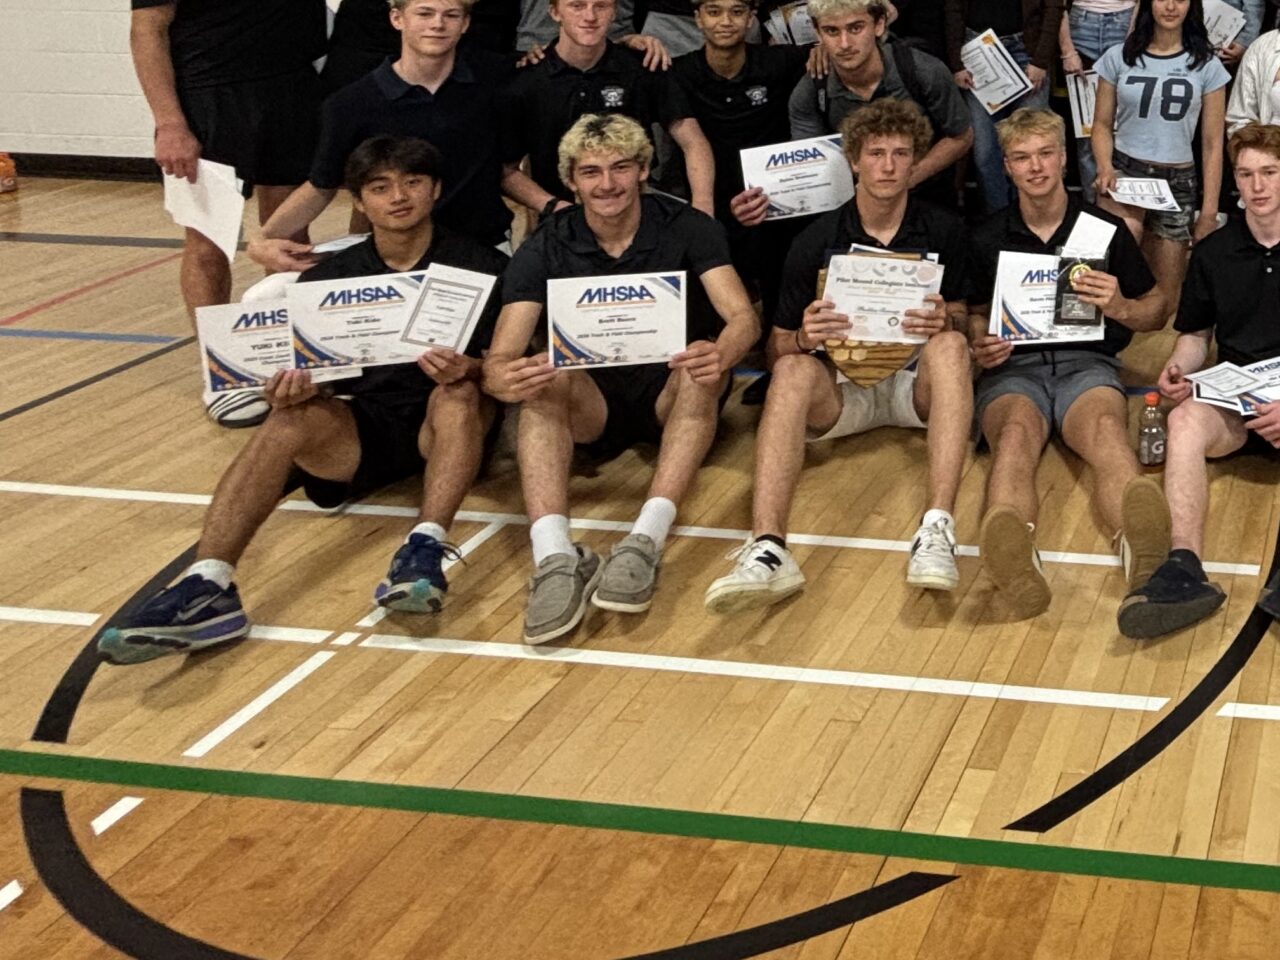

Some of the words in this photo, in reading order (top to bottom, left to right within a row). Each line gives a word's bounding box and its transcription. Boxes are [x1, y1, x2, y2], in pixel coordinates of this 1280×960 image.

[1125, 75, 1194, 122] 78
[766, 147, 826, 168] MHSAA
[319, 285, 404, 307] MHSAA
[577, 285, 655, 304] MHSAA
[1151, 440, 1164, 454] G
[756, 550, 782, 572] N
